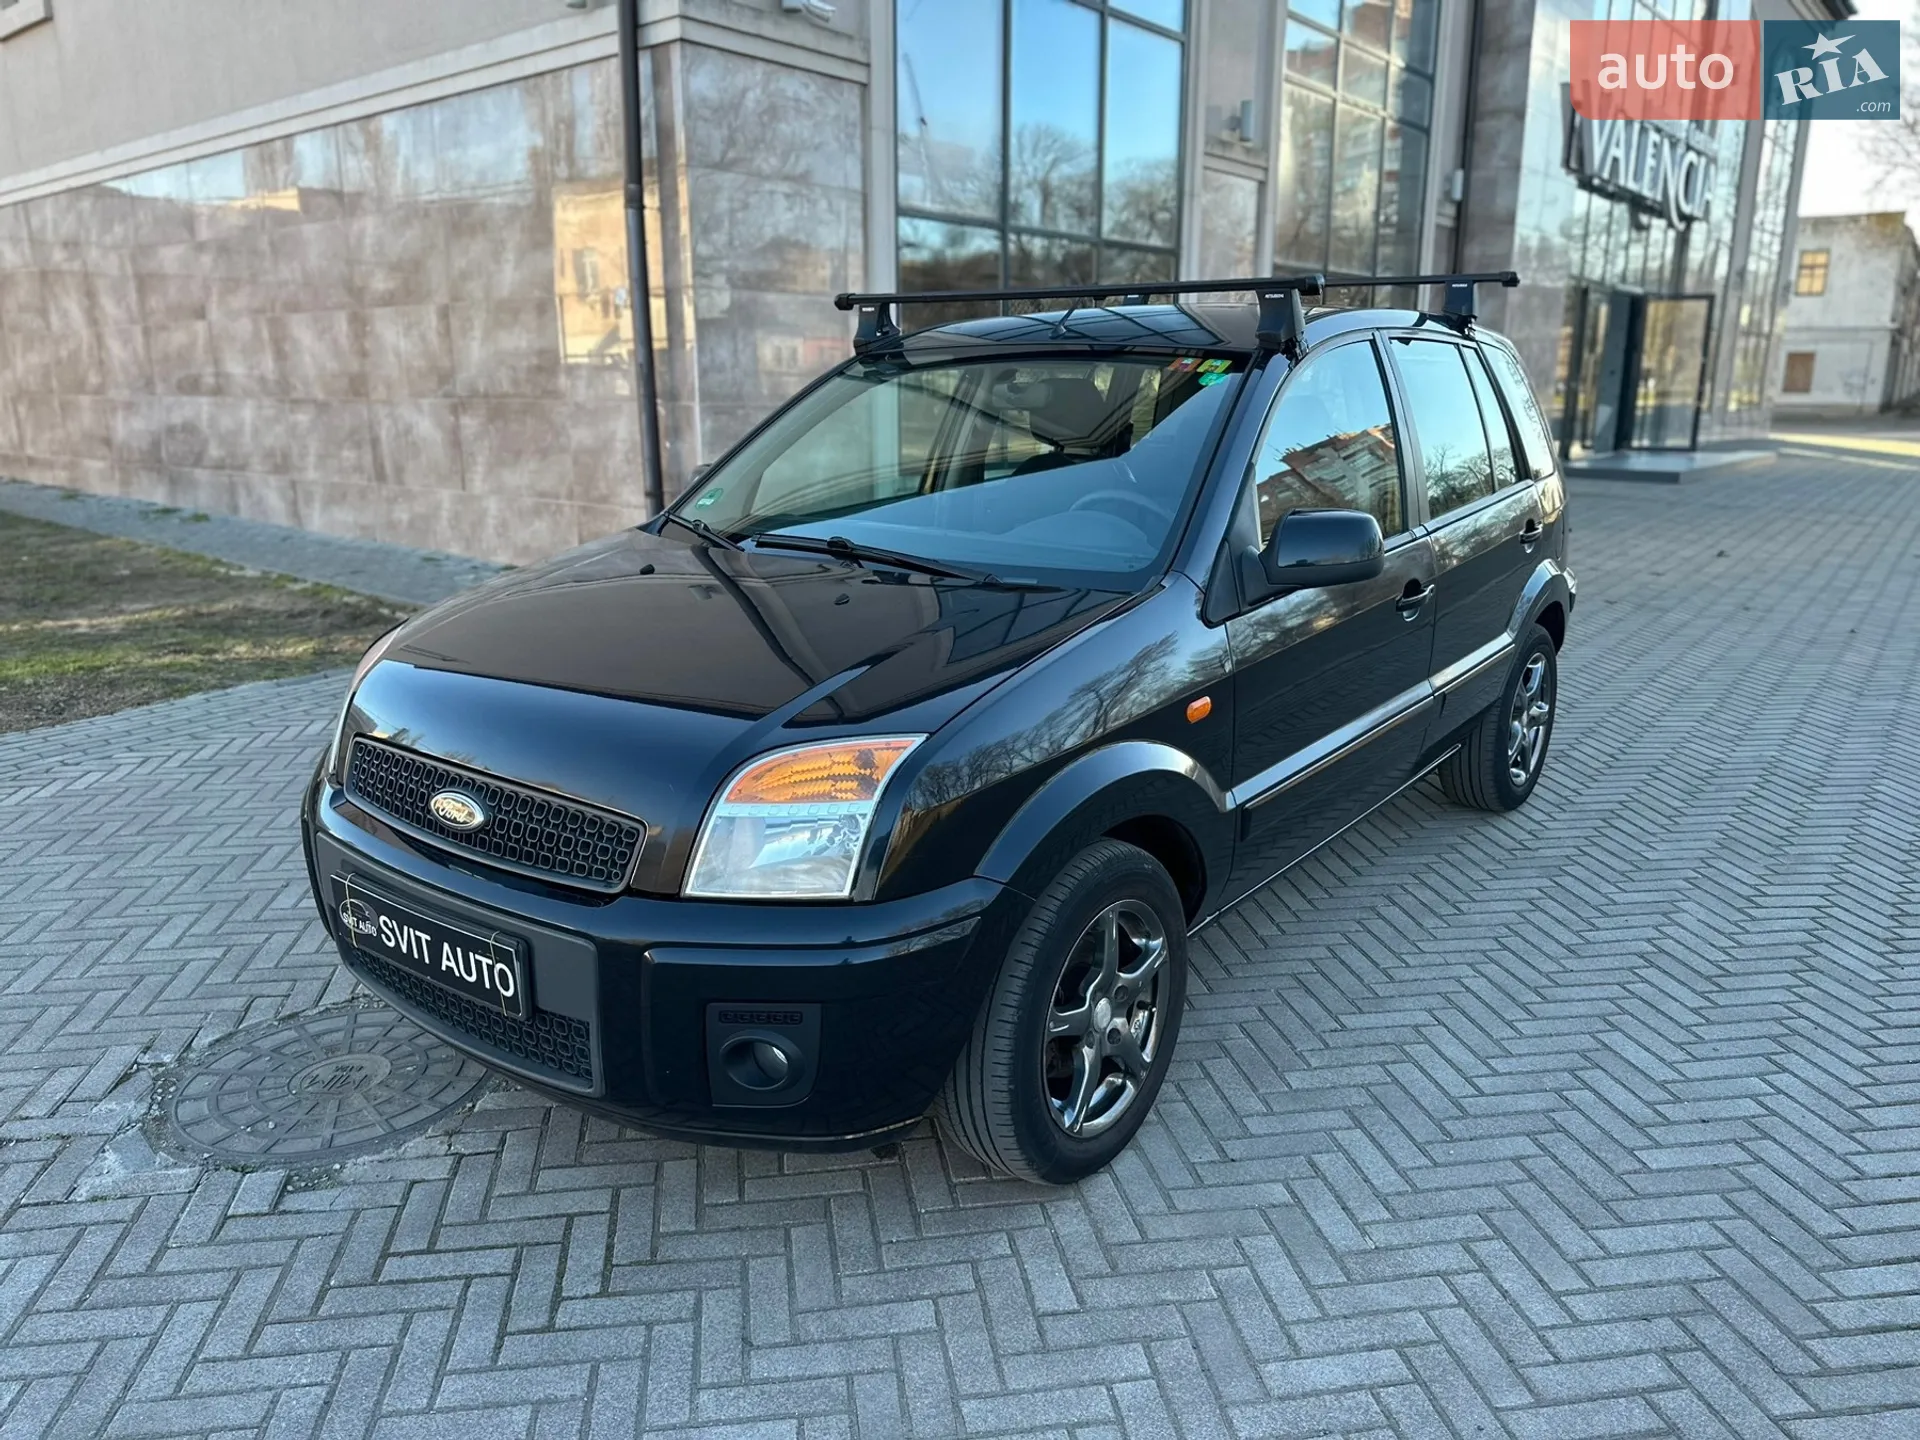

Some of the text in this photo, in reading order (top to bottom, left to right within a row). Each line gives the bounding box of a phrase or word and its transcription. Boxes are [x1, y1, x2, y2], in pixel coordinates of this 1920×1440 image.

[359, 920, 377, 937] AUTO
[378, 915, 515, 998] SVIT AUTO
